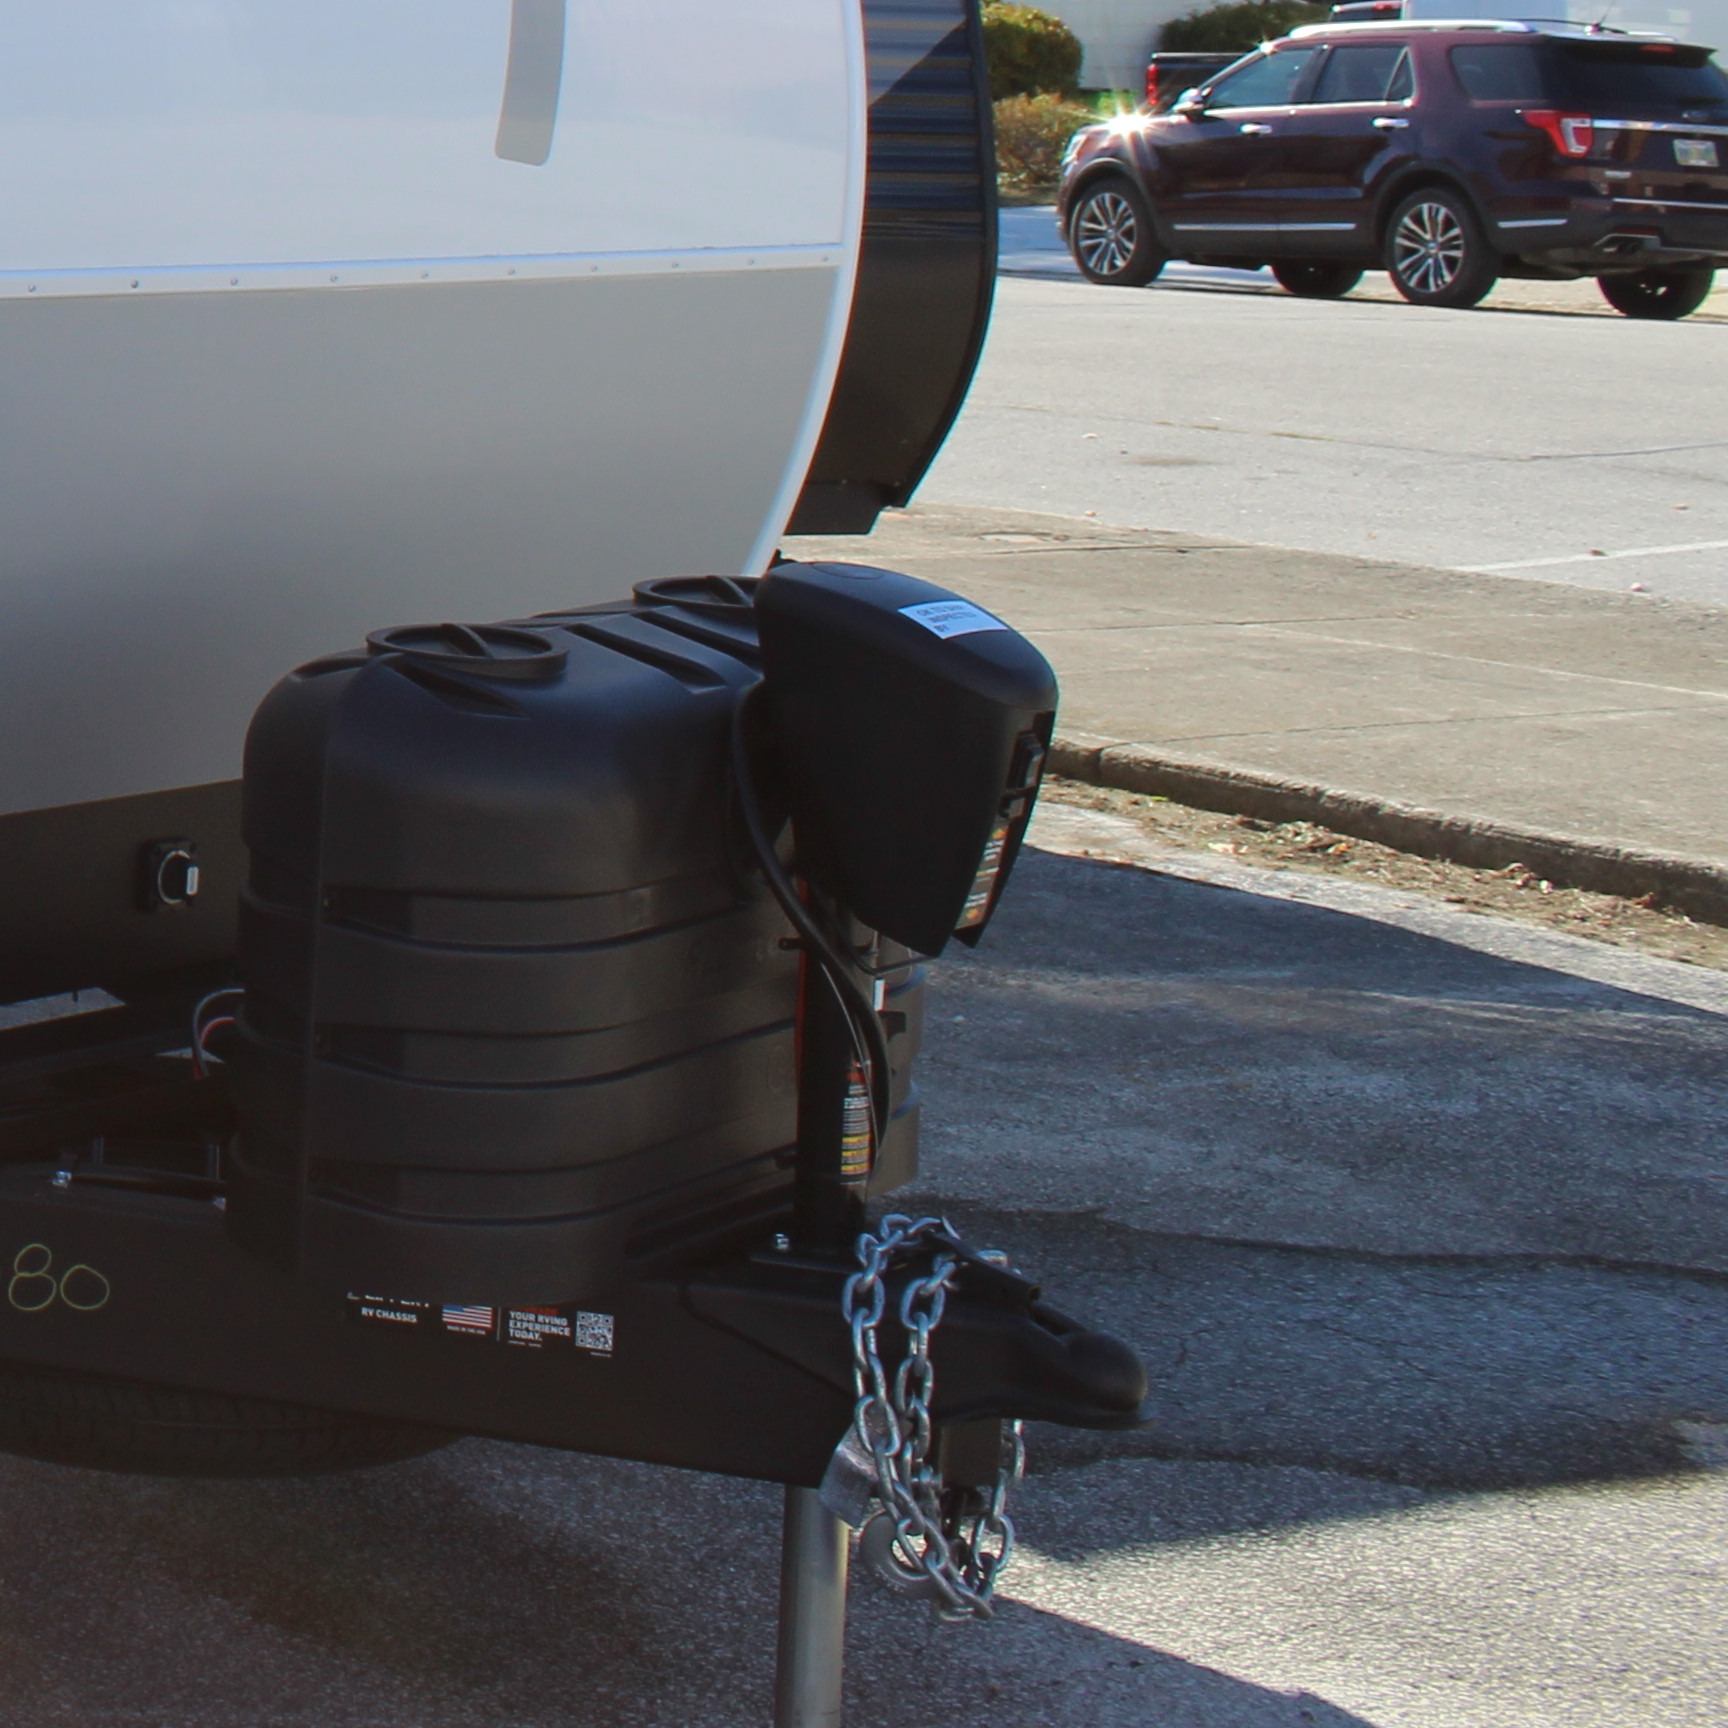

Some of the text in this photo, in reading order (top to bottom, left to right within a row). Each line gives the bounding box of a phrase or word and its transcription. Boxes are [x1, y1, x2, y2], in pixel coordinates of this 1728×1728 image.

[375, 1308, 418, 1323] CHASSIS
[509, 1310, 536, 1321] YOUR
[509, 1319, 572, 1337] EXPERIENCE
